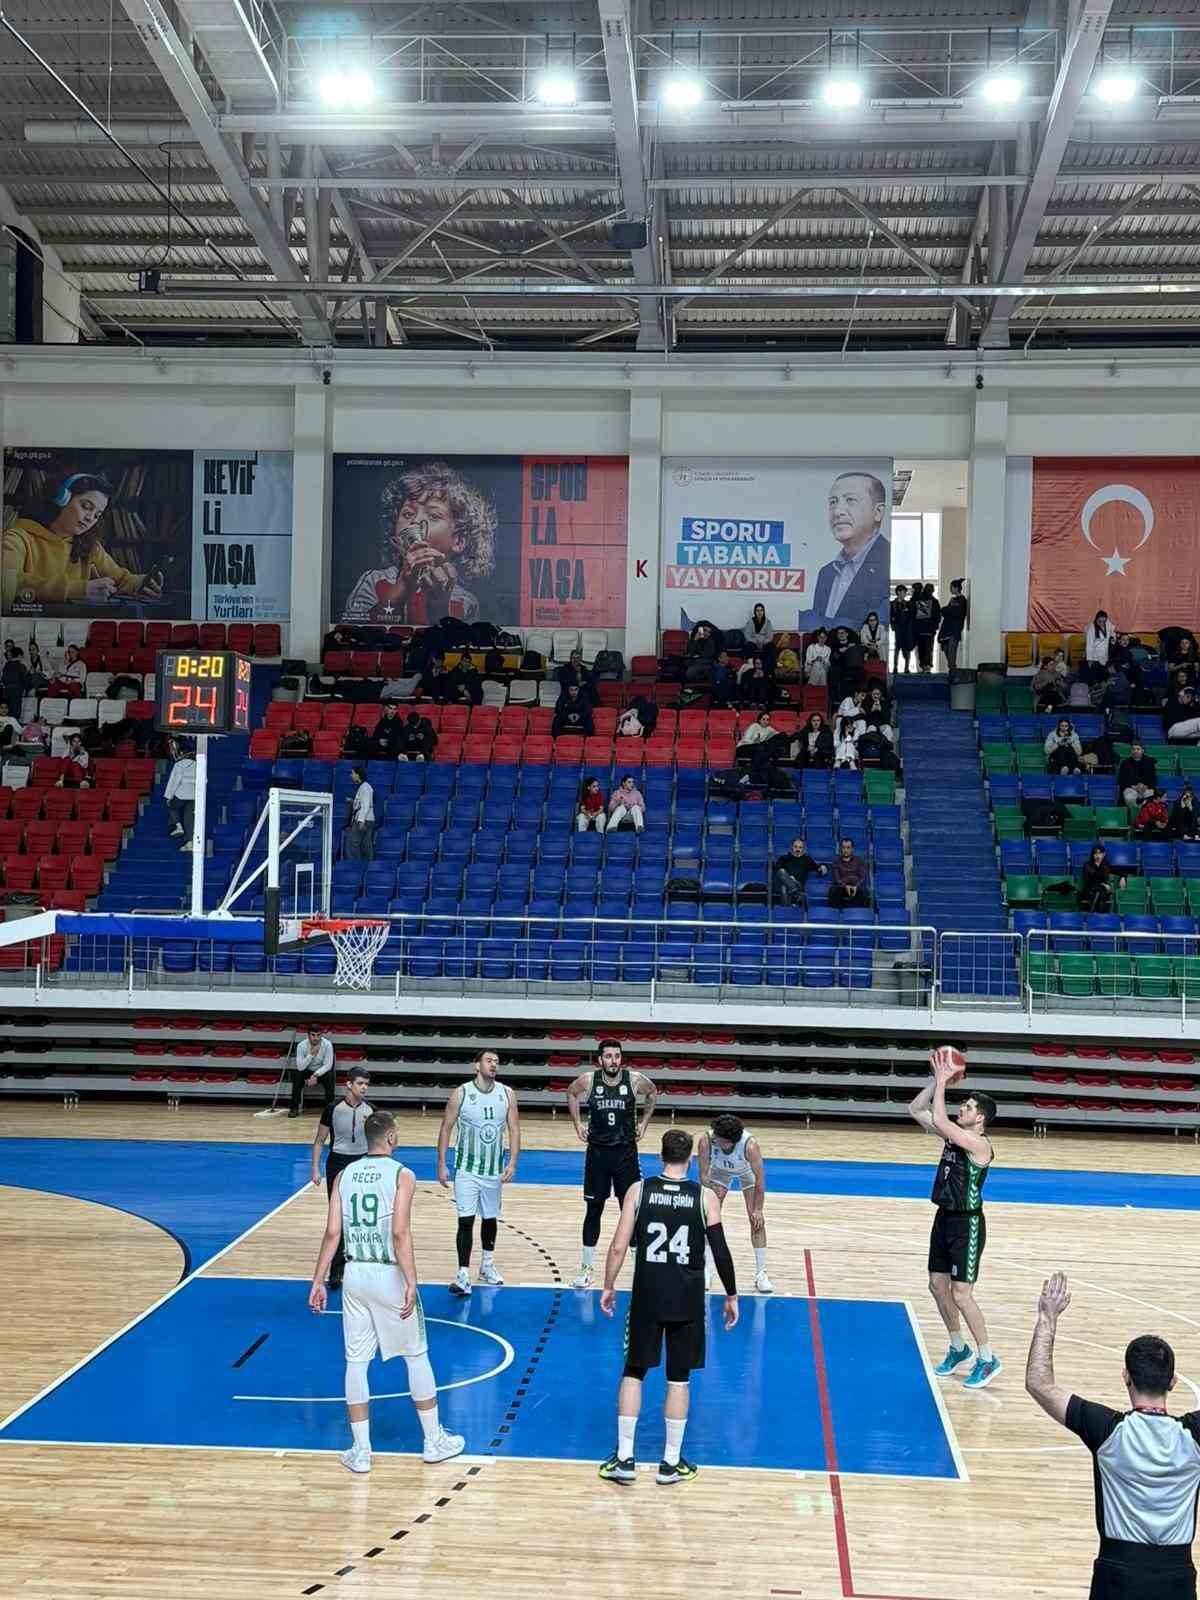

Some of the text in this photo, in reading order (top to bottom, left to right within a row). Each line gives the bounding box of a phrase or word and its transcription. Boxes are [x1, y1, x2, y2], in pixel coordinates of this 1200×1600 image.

[531, 506, 557, 545] LA
[690, 519, 771, 543] SPORU
[203, 543, 256, 589] YAŞA
[683, 545, 781, 566] TABANA
[636, 559, 649, 578] K
[668, 567, 802, 591] YAYIYORUZ
[528, 558, 586, 605] YAŞA
[213, 605, 254, 618] Yurtları
[176, 655, 225, 678] 8:20
[168, 686, 217, 725] 24
[484, 1106, 494, 1120] 11
[608, 1112, 616, 1126] 9
[351, 1172, 383, 1184] RECEP
[349, 1192, 379, 1228] 19
[645, 1221, 691, 1265] 24
